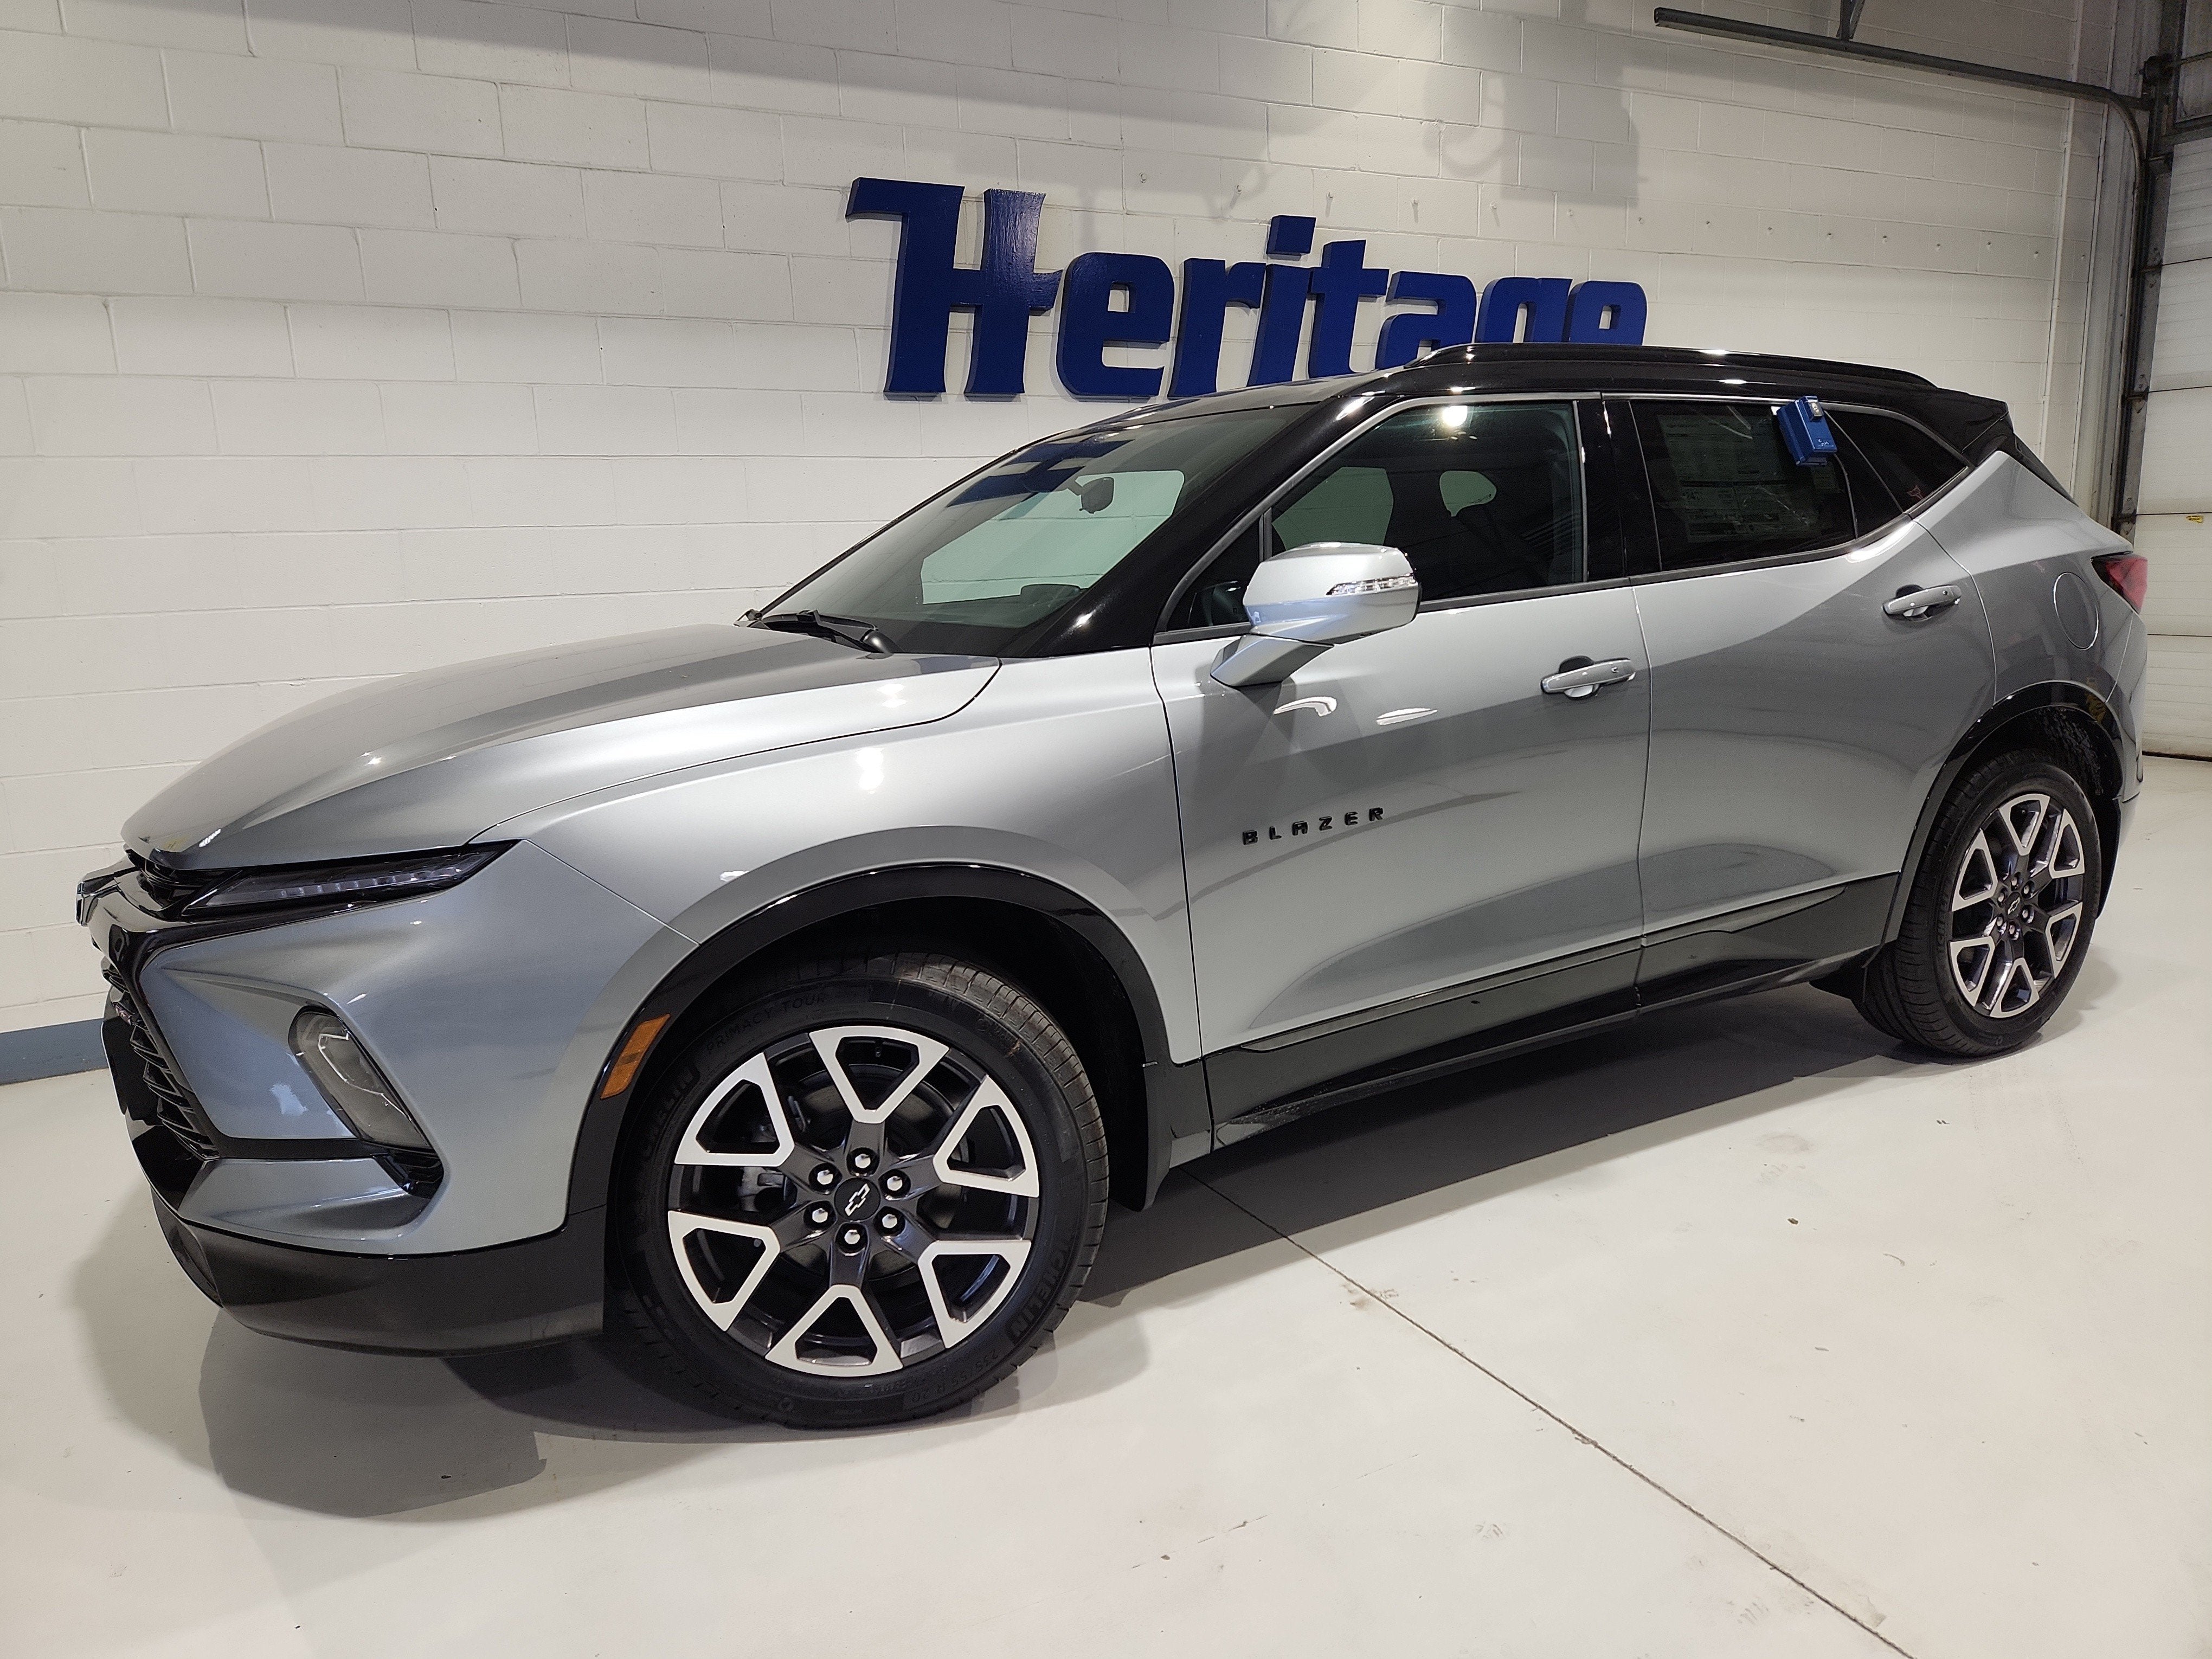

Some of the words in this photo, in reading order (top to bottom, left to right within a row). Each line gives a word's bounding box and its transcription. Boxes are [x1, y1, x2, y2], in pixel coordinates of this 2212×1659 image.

[1242, 807, 1384, 845] BLAZER
[705, 1005, 774, 1055] PRIMACY
[781, 992, 826, 1013] TOUR
[911, 1388, 929, 1404] 20
